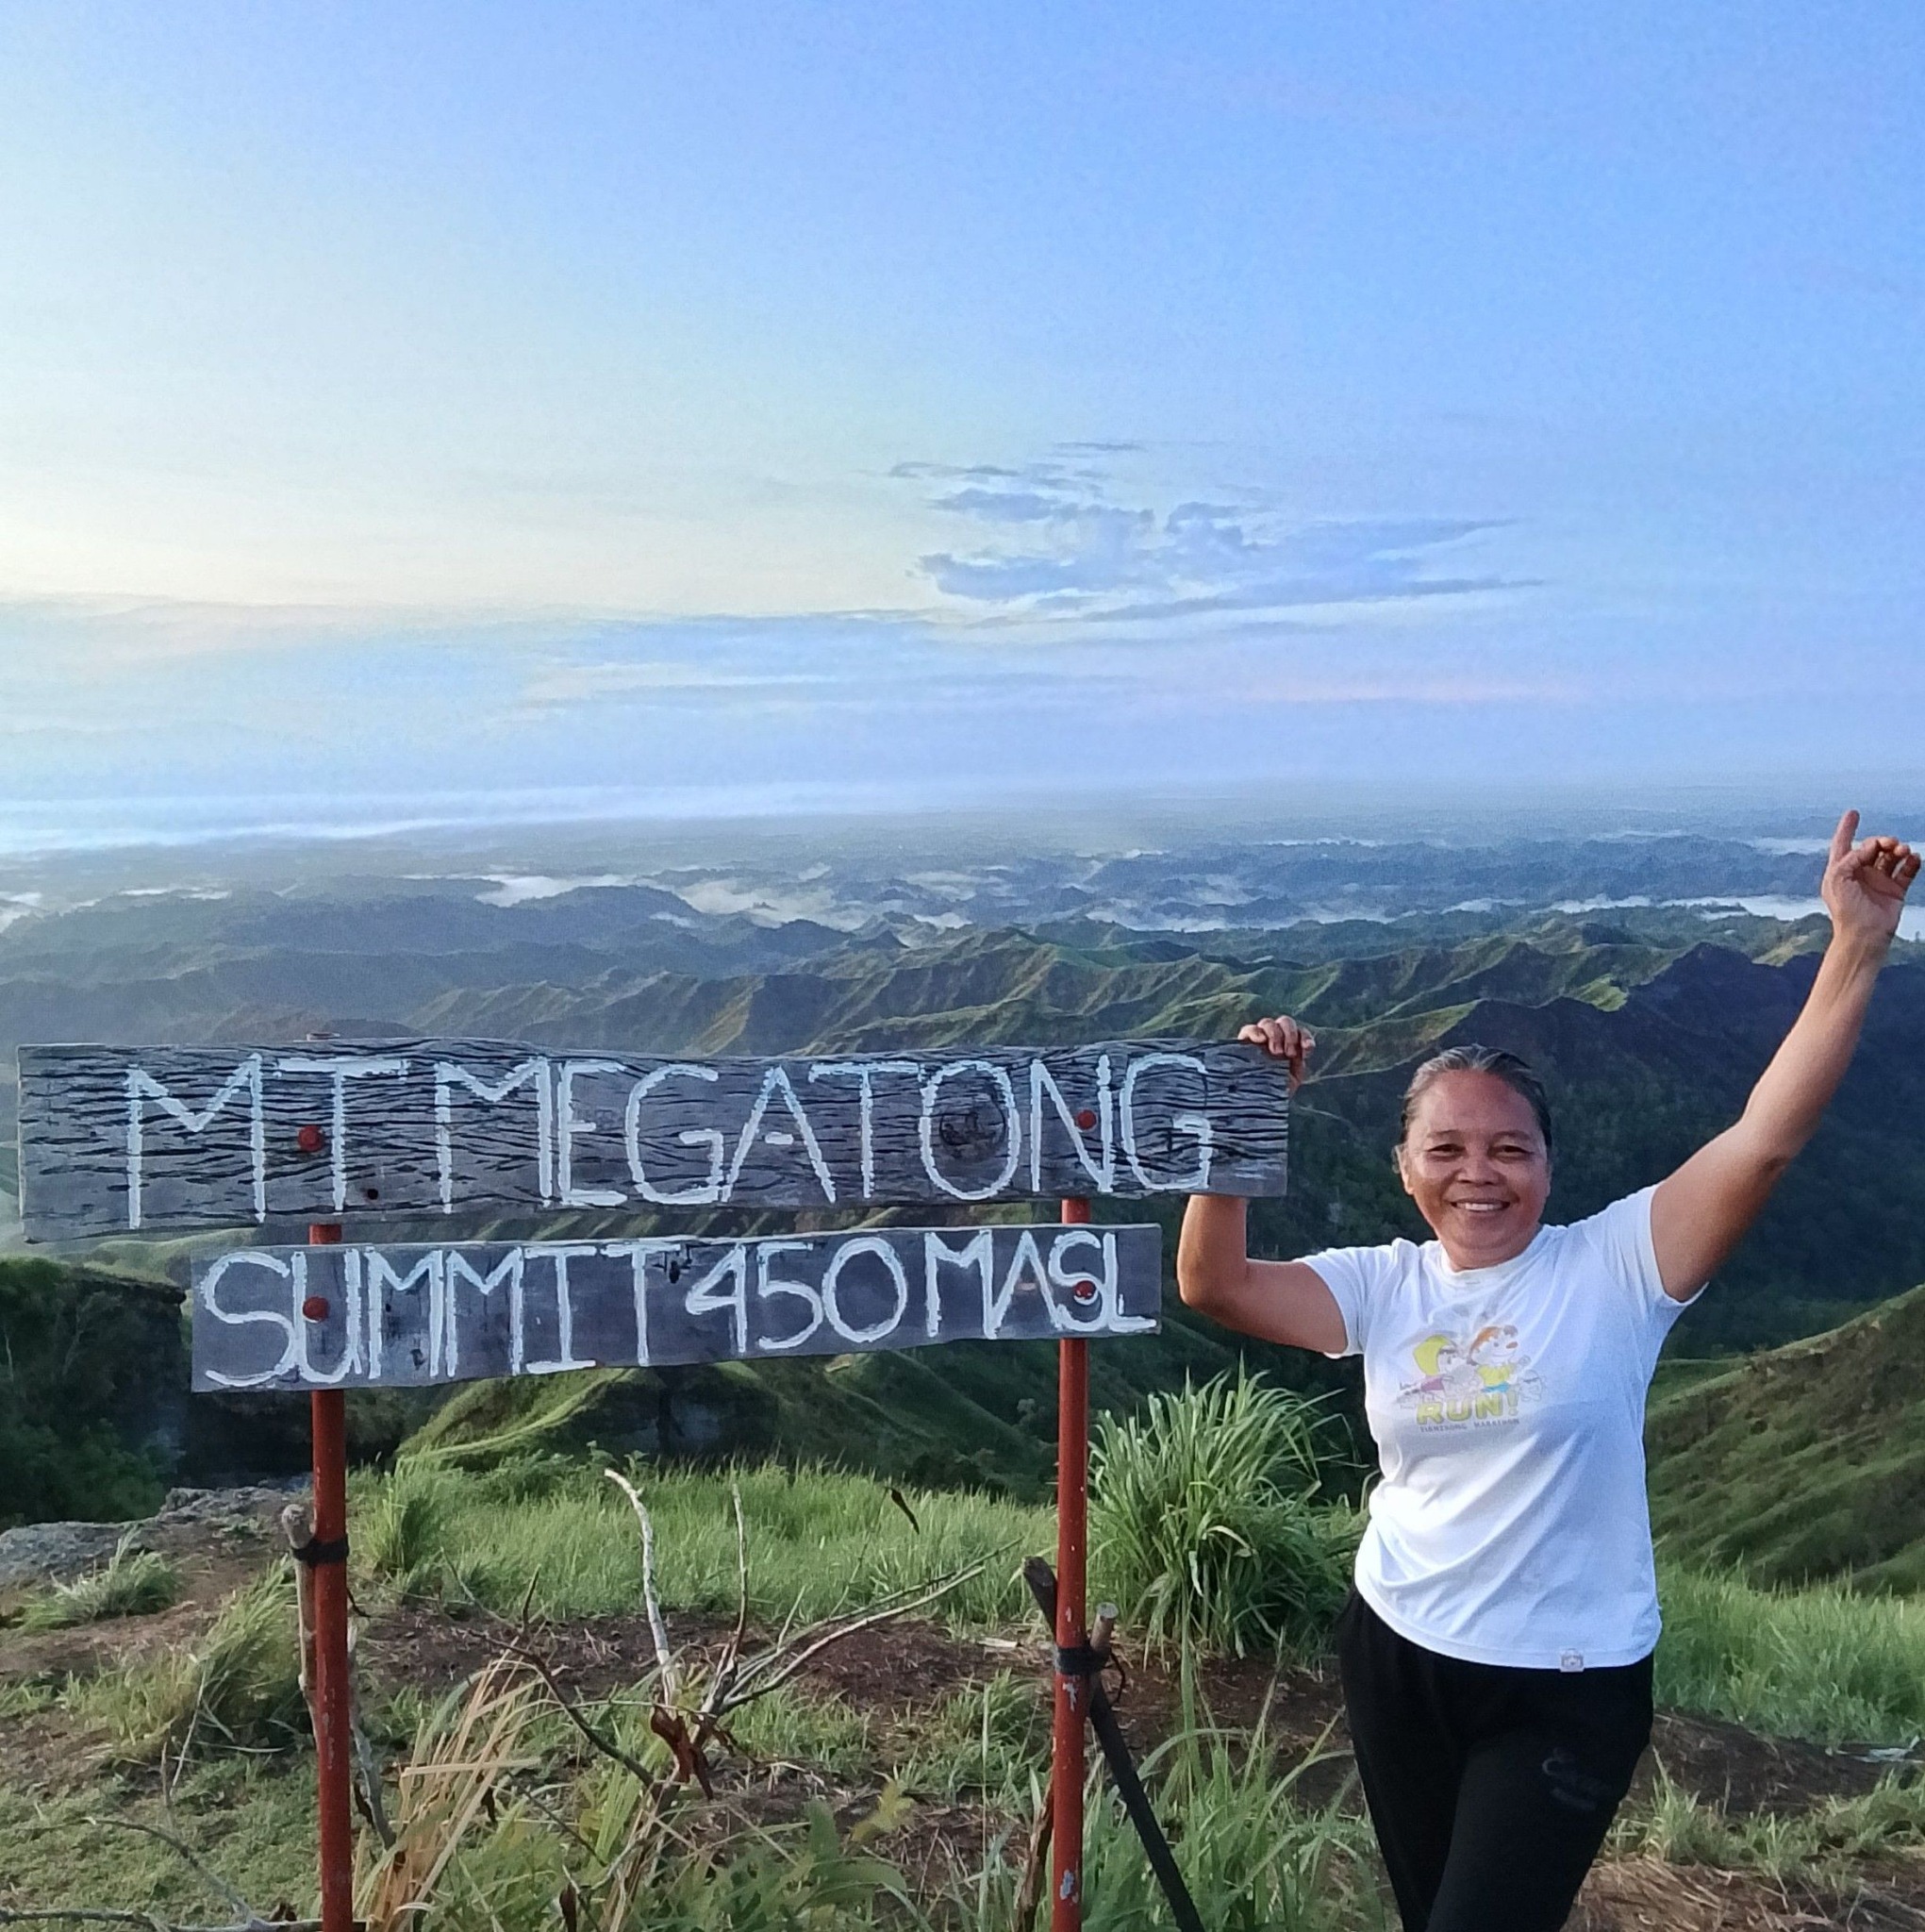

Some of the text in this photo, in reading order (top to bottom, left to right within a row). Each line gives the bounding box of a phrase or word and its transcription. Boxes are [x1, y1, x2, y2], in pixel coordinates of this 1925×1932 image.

[435, 1053, 1213, 1214] MEGATONG
[198, 1230, 1157, 1387] SUMMIT 450 MASL
